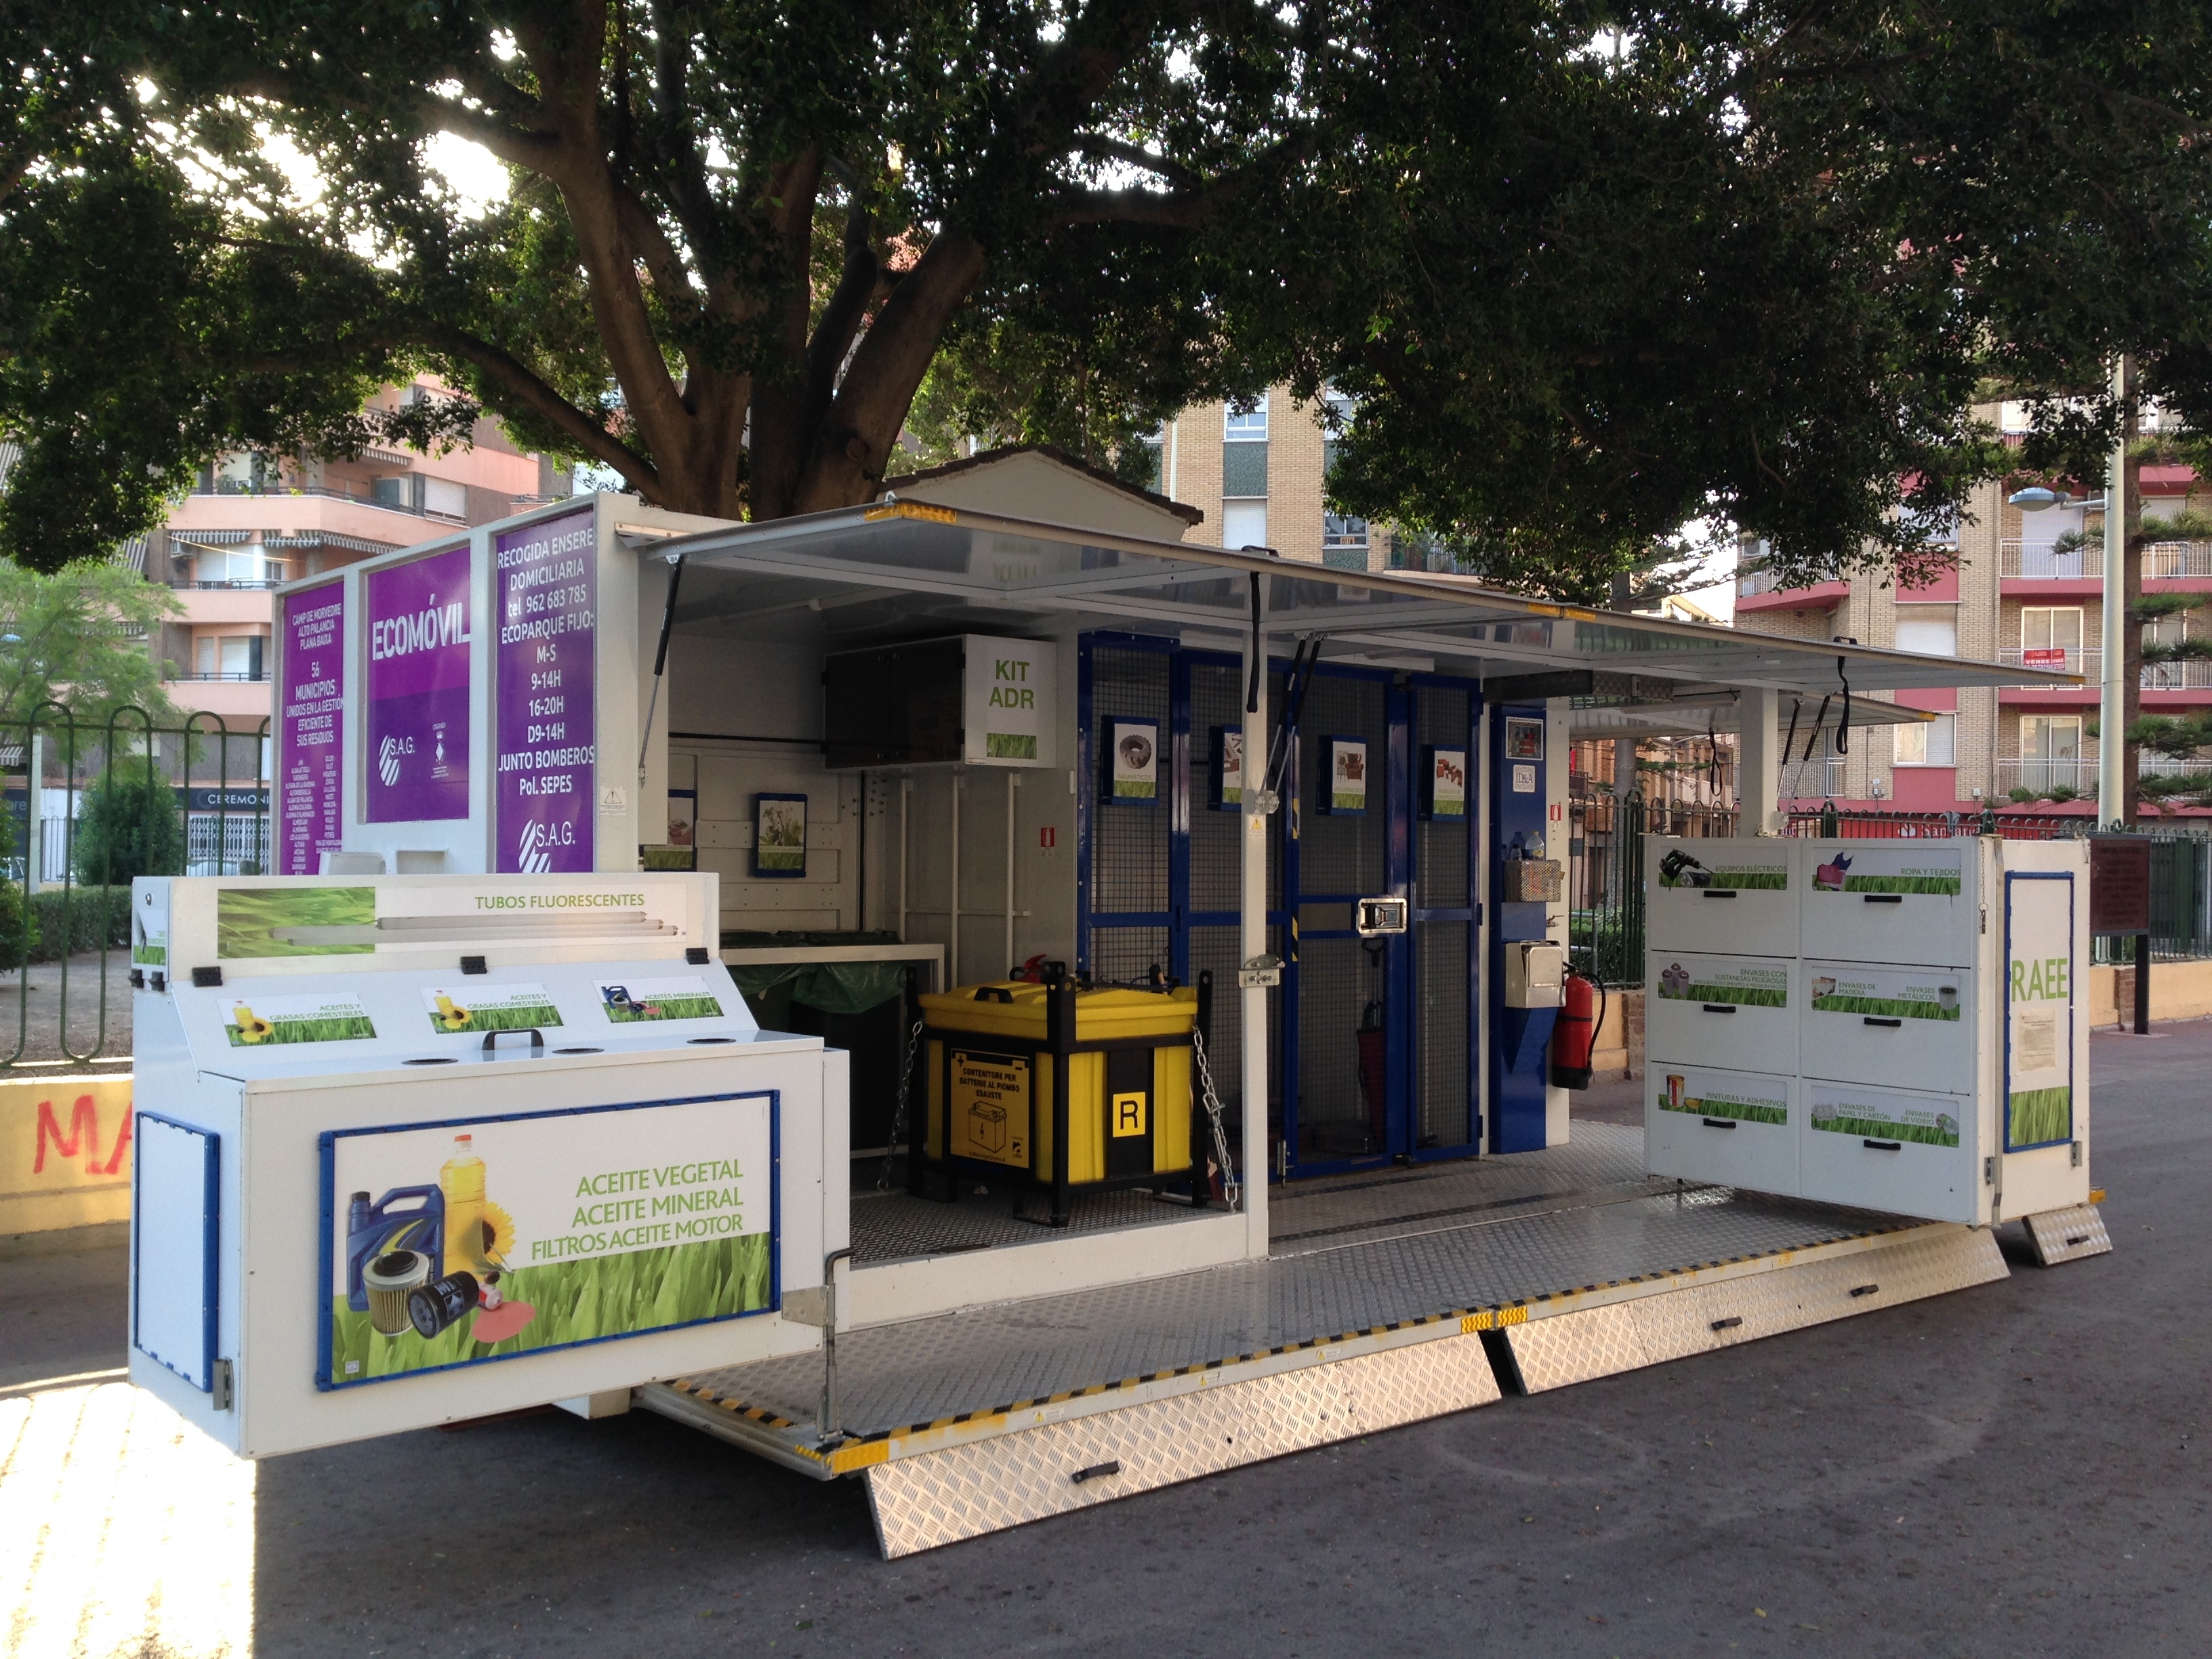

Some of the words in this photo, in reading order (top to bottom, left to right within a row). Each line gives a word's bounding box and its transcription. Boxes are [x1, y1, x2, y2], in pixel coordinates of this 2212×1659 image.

[497, 539, 550, 569] RECOGIDA
[510, 557, 584, 591] DOMICILIARIA
[508, 596, 522, 617] tel
[526, 593, 544, 613] 962
[547, 588, 565, 609] 683
[568, 583, 586, 605] 785
[293, 612, 306, 626] CAMP
[306, 611, 313, 622] DE
[298, 624, 310, 637] ALTO
[311, 619, 335, 634] PALANCIA
[372, 593, 470, 661] ECOMÓVIL
[501, 615, 565, 644] ECOPARQUE
[567, 610, 594, 632] FIJO:
[300, 636, 316, 651] PLANA
[316, 632, 331, 647] BAIXA
[536, 643, 556, 663] M-S
[311, 661, 320, 678] 56
[996, 659, 1030, 682] KIT
[531, 669, 561, 691] 9-14H
[295, 679, 335, 701] MUNICIPIOS
[989, 687, 1034, 710] ADR
[286, 703, 306, 717] UNIDOS
[306, 702, 314, 714] EN
[314, 701, 321, 713] LA
[529, 695, 564, 717] 16-20H
[298, 716, 324, 731] EFICIENTE
[325, 714, 332, 727] DE
[296, 733, 308, 747] SUS
[308, 730, 333, 745] RESIDUOS
[527, 722, 565, 743] D9-14H
[390, 736, 415, 755] S.A.G.
[498, 752, 533, 771] JUNTO
[535, 745, 594, 769] BOMBEROS
[519, 775, 539, 796] Pol.
[541, 775, 572, 794] SEPES
[536, 821, 575, 847] S.A.G.
[1747, 864, 1787, 872] ELÉCTRICOS
[474, 896, 526, 909] TUBOS
[530, 893, 644, 908] FLUORESCENTES
[1839, 982, 1866, 990] ENVASES
[2011, 958, 2068, 1002] RAEE
[499, 1000, 550, 1008] COMESTIBLES
[963, 1067, 1003, 1080] CONTENITORE
[1004, 1073, 1016, 1082] PER
[959, 1078, 987, 1088] BATTERIE
[996, 1082, 1020, 1092] PIOMBO
[976, 1089, 1002, 1100] ESAUSTE
[1706, 1092, 1739, 1102] PINTURAS
[1746, 1097, 1787, 1108] ADHESIVOS
[1839, 1103, 1866, 1111] ENVASES
[1120, 1099, 1139, 1130] R
[1863, 1112, 1891, 1121] CARTÓN
[1906, 1109, 1933, 1118] ENVASES
[1911, 1117, 1933, 1125] VIDRIO
[575, 1168, 649, 1198] ACEITE
[653, 1158, 743, 1188] VEGETAL
[571, 1198, 646, 1228] ACEITE
[651, 1187, 743, 1217] MINERAL
[531, 1232, 607, 1261] FILTROS
[609, 1223, 672, 1249] ACEITE
[676, 1213, 743, 1240] MOTOR
